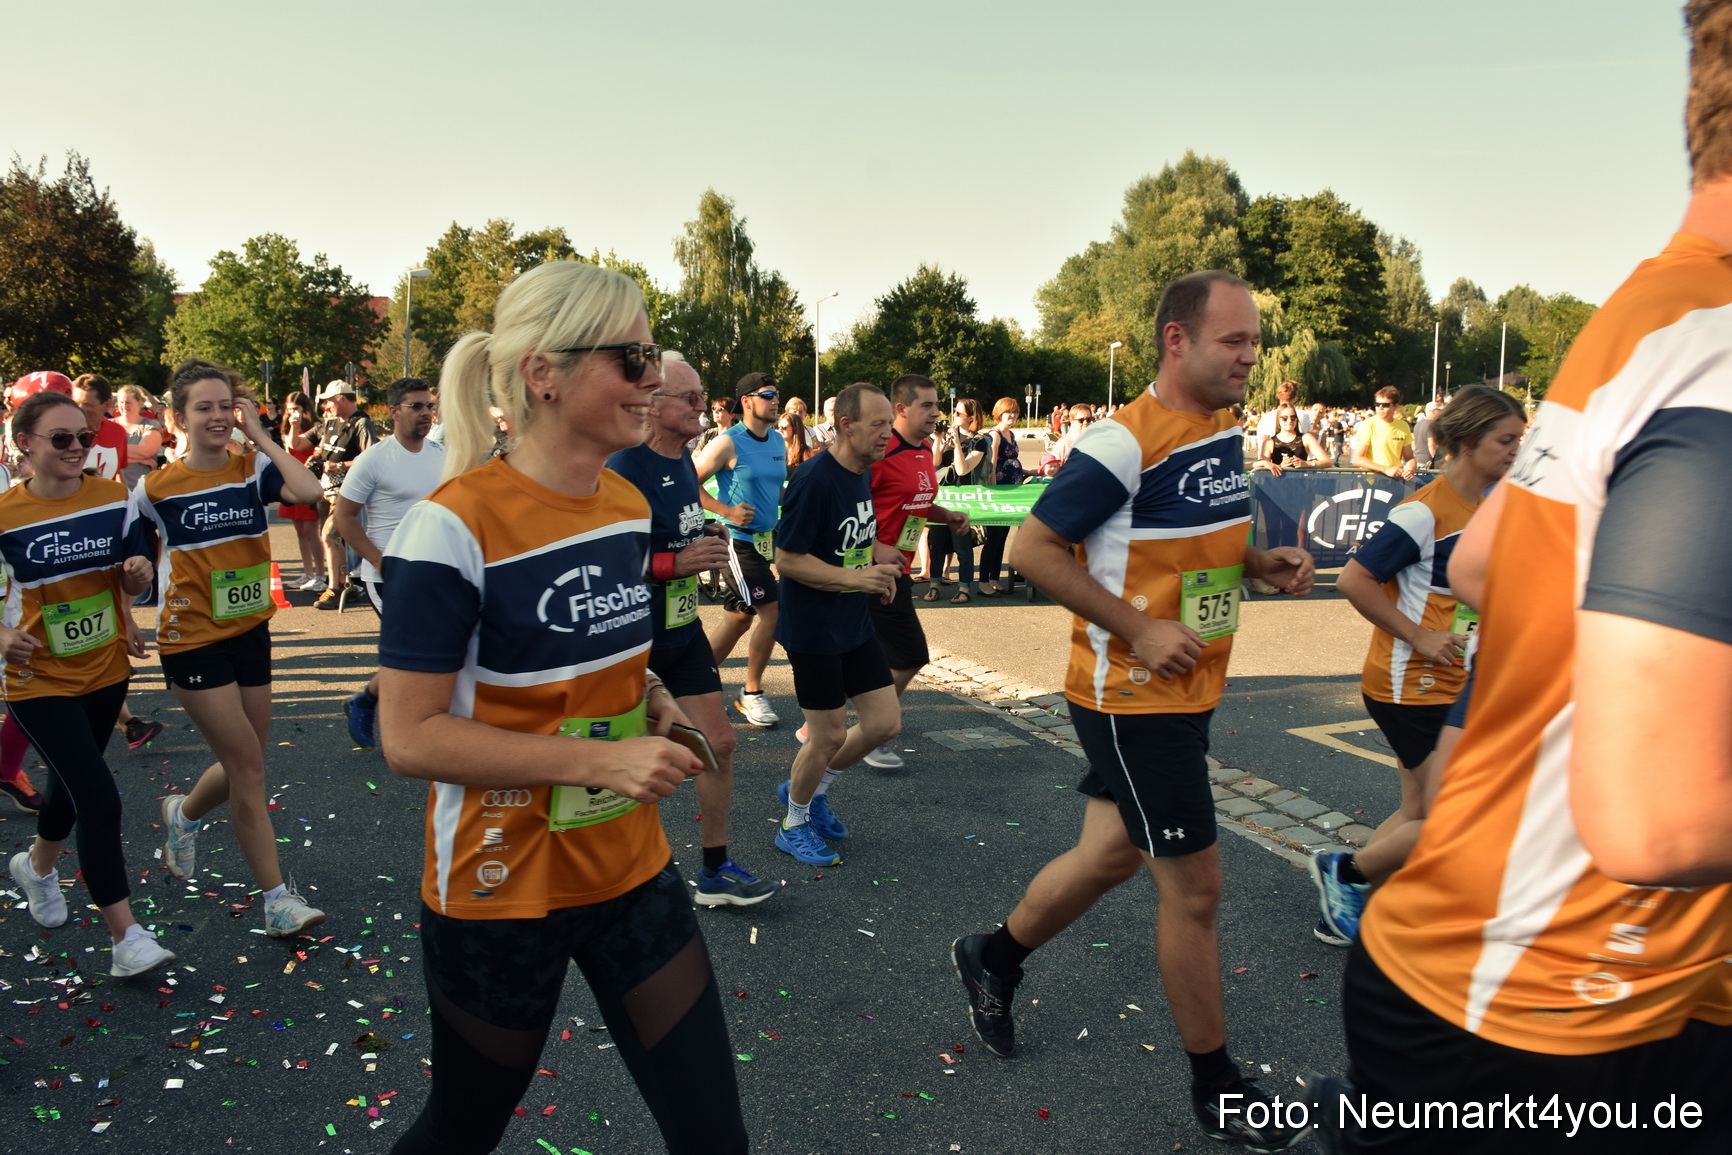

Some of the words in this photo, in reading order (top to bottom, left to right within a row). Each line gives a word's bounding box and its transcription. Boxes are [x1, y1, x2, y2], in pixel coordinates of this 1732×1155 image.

[194, 507, 254, 526] Fischer
[202, 518, 254, 532] AUTOMOBILE
[43, 536, 113, 559] Fischer
[53, 548, 111, 565] AUTOMOBILE
[228, 582, 262, 605] 608
[1198, 592, 1231, 622] 575
[64, 611, 104, 640] 607
